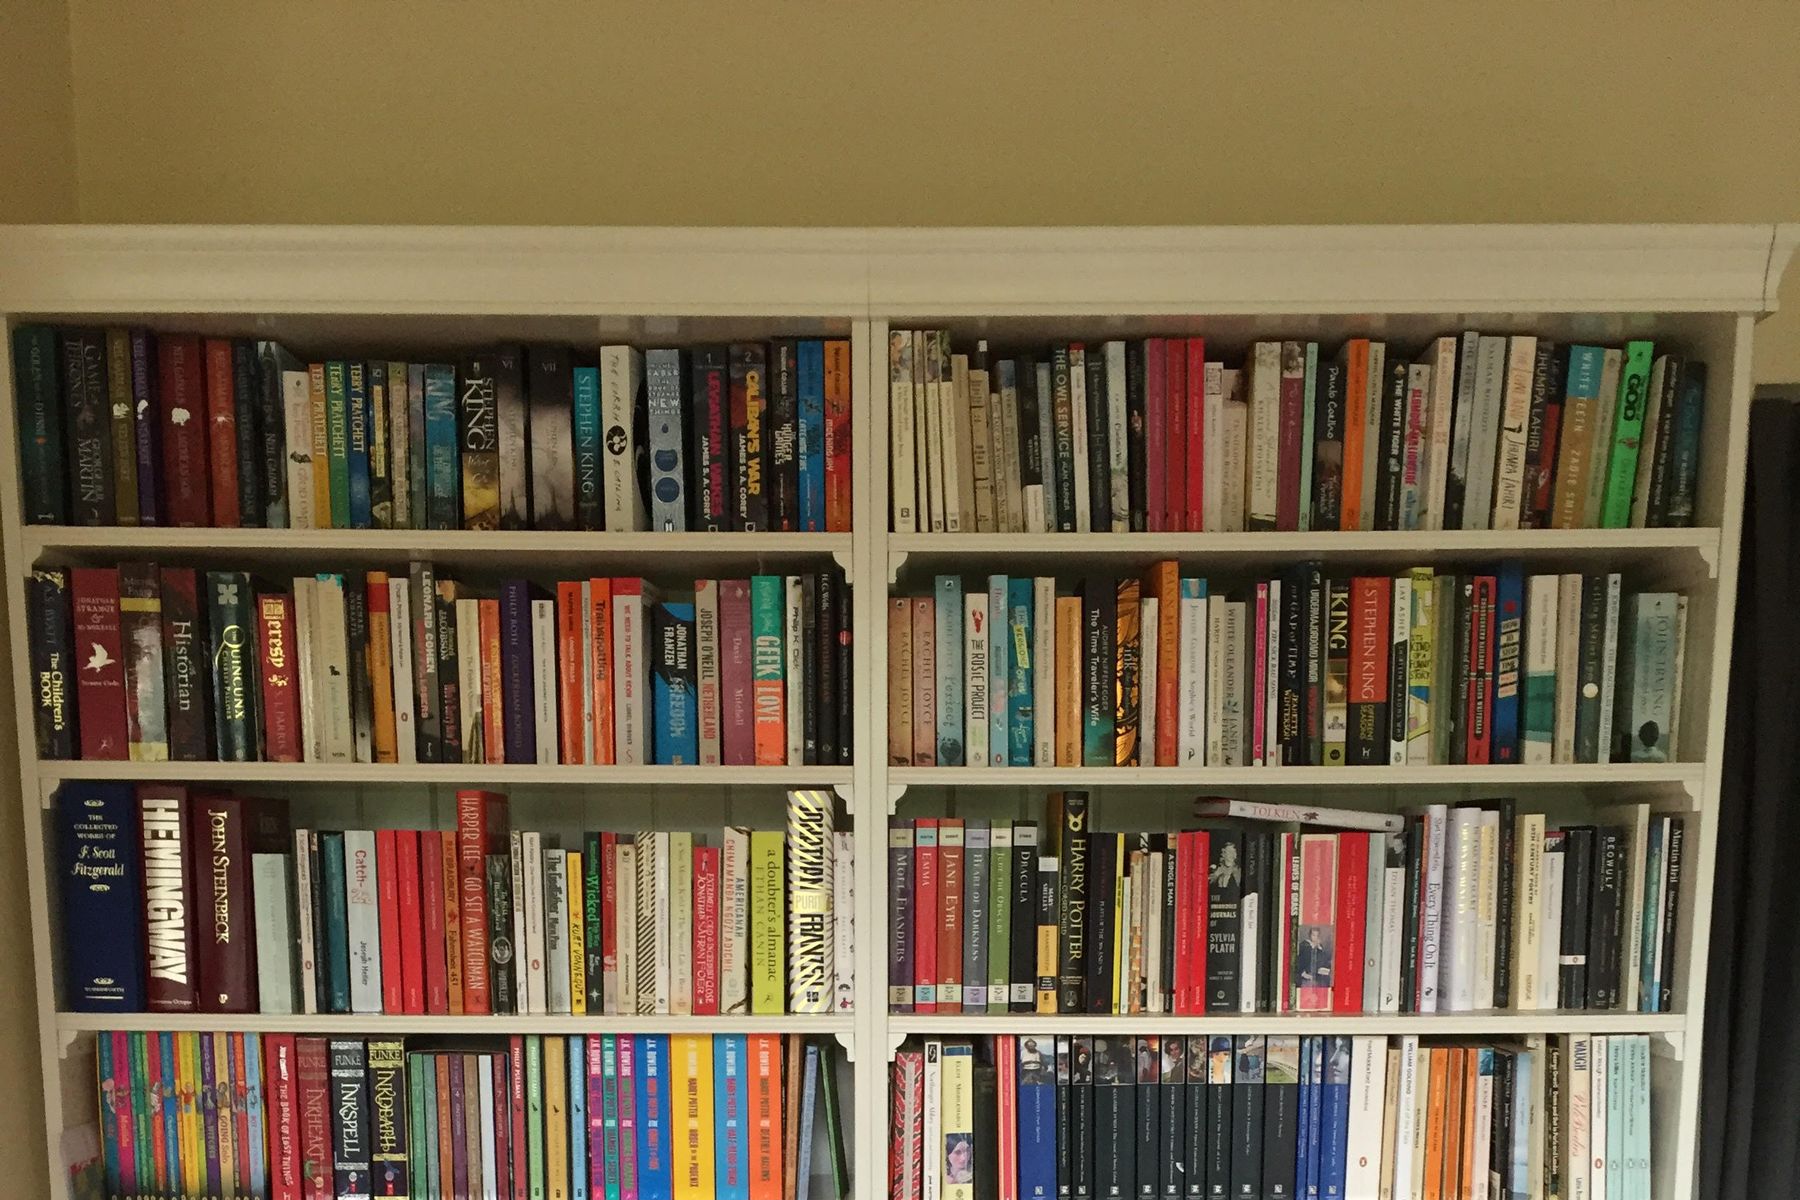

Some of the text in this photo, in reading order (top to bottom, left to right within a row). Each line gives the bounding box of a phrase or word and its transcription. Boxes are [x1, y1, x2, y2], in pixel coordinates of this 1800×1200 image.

[1577, 352, 1593, 390] WHITE
[461, 378, 486, 450] KING
[483, 377, 497, 450] STEPHEN
[1056, 348, 1070, 458] THE OWL SERVICE
[578, 375, 596, 494] STEPHEN KING
[745, 457, 761, 496] WAR
[664, 627, 675, 666] FRANZEN
[677, 624, 688, 670] JONATHAN
[1330, 592, 1348, 650] KING
[1361, 589, 1378, 699] STEPHEN KING
[41, 672, 53, 707] BOOK
[171, 621, 194, 711] Historian
[755, 635, 782, 724] GEEK LOVE
[1090, 609, 1101, 727] The Time Traveler's Wife
[51, 671, 66, 731] Children's
[461, 797, 481, 840] HARPER
[208, 809, 231, 945] JOHN STEINBECK
[463, 845, 481, 861] LEE
[1020, 851, 1032, 903] DRACULA
[141, 799, 188, 984] HEMINGWAY
[464, 877, 480, 891] GO
[465, 896, 483, 914] SET
[767, 861, 783, 923] doubter's
[943, 852, 959, 931] JANE EYRE
[1069, 839, 1087, 961] HARRY POTTER
[1426, 882, 1441, 909] Every
[767, 926, 782, 982] almanac
[1210, 933, 1236, 943] SYLVIA
[1210, 943, 1236, 954] PLATH
[1424, 912, 1440, 942] Thing
[1425, 944, 1439, 959] On
[466, 929, 486, 990] WATCHMAN
[1573, 1041, 1587, 1070] WAUGH
[339, 1083, 361, 1160] INKSPELL
[374, 1070, 398, 1153] INKDEATH
